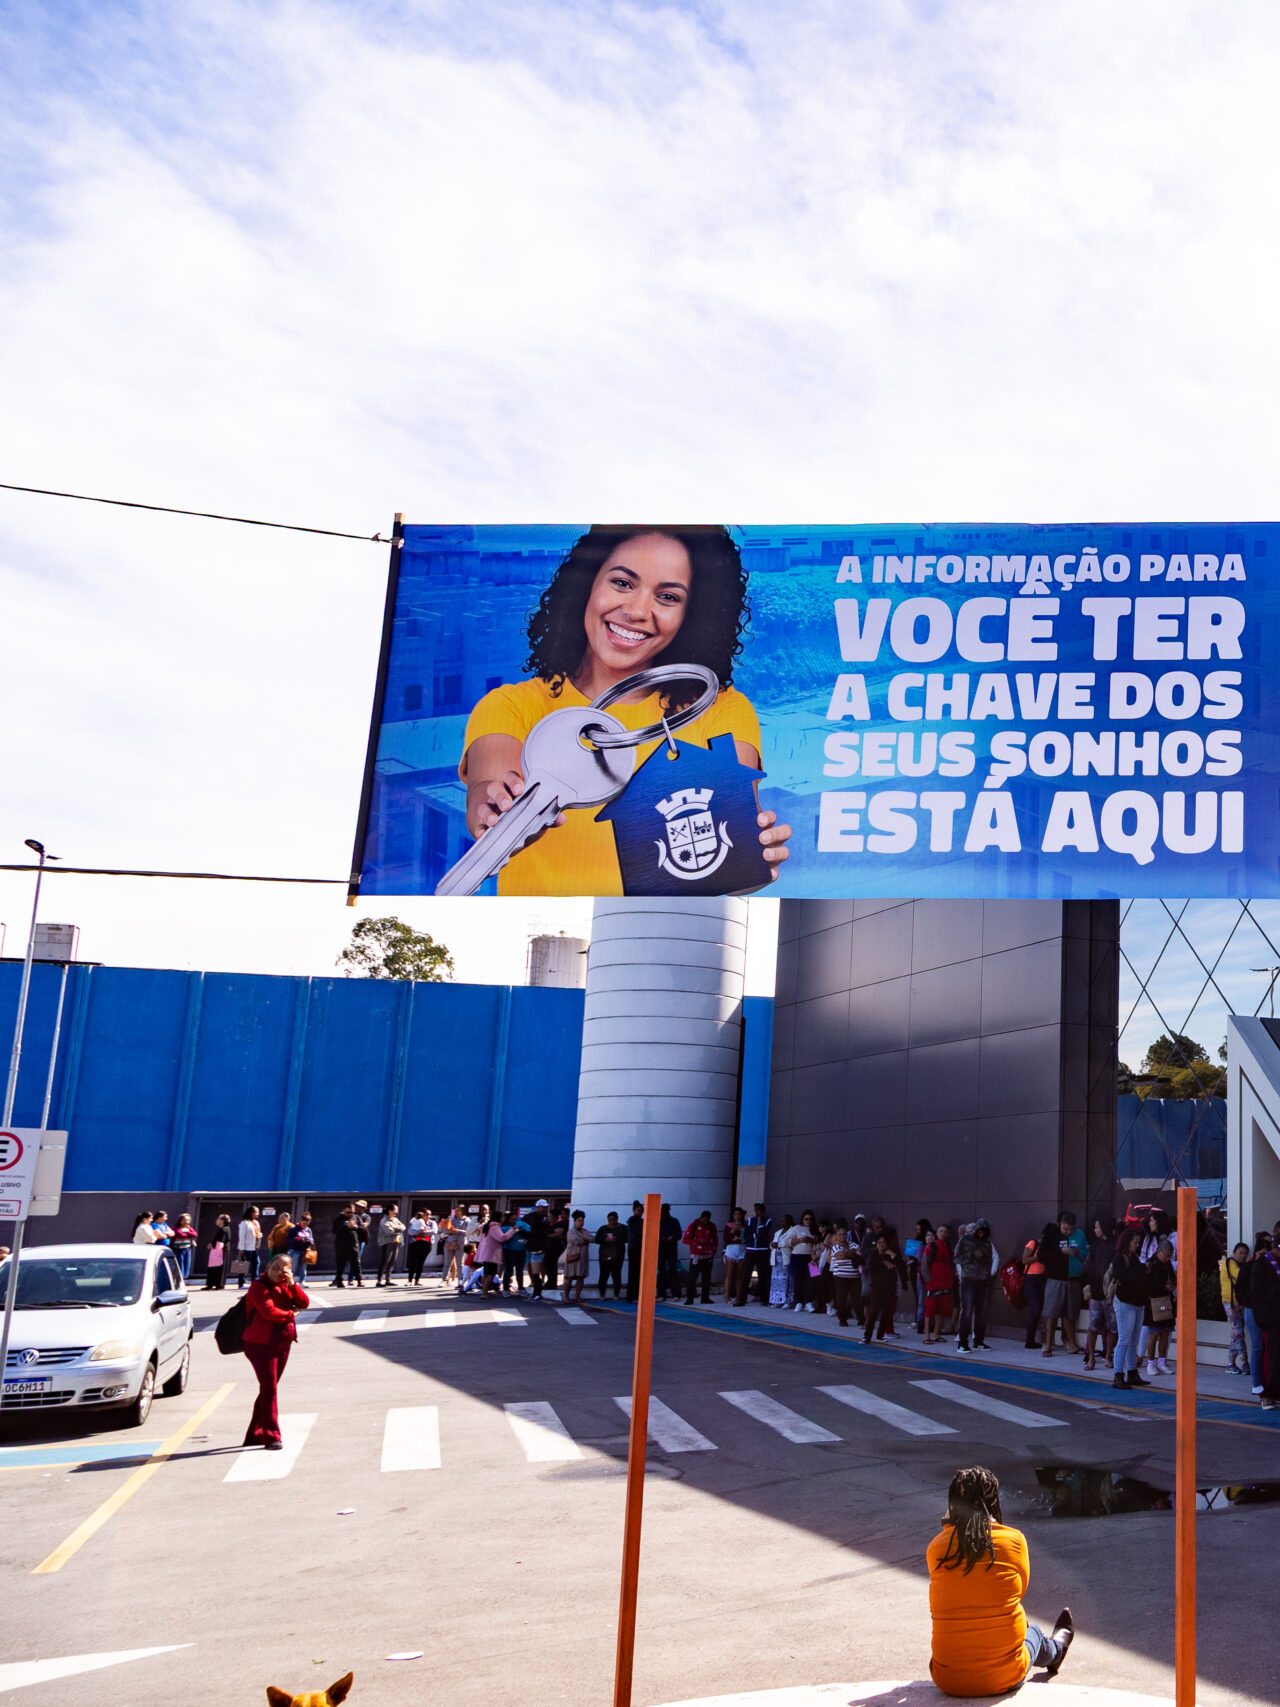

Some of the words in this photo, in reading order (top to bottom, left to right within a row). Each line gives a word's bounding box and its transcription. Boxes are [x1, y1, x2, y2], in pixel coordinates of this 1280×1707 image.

[836, 555, 862, 583] A
[872, 547, 1131, 591] INFORMAÇÃO
[1140, 553, 1246, 582] PARA
[835, 580, 1060, 663] VOCÊ
[1082, 596, 1246, 661] TER
[827, 673, 871, 720] A
[888, 672, 1095, 721] CHAVE
[1109, 670, 1243, 719] DOS
[823, 732, 976, 777] SEUS
[990, 730, 1243, 777] SONHOS
[818, 775, 1022, 853] ESTÁ
[1042, 791, 1244, 866] AQUI
[2, 1382, 45, 1393] OC6H11
